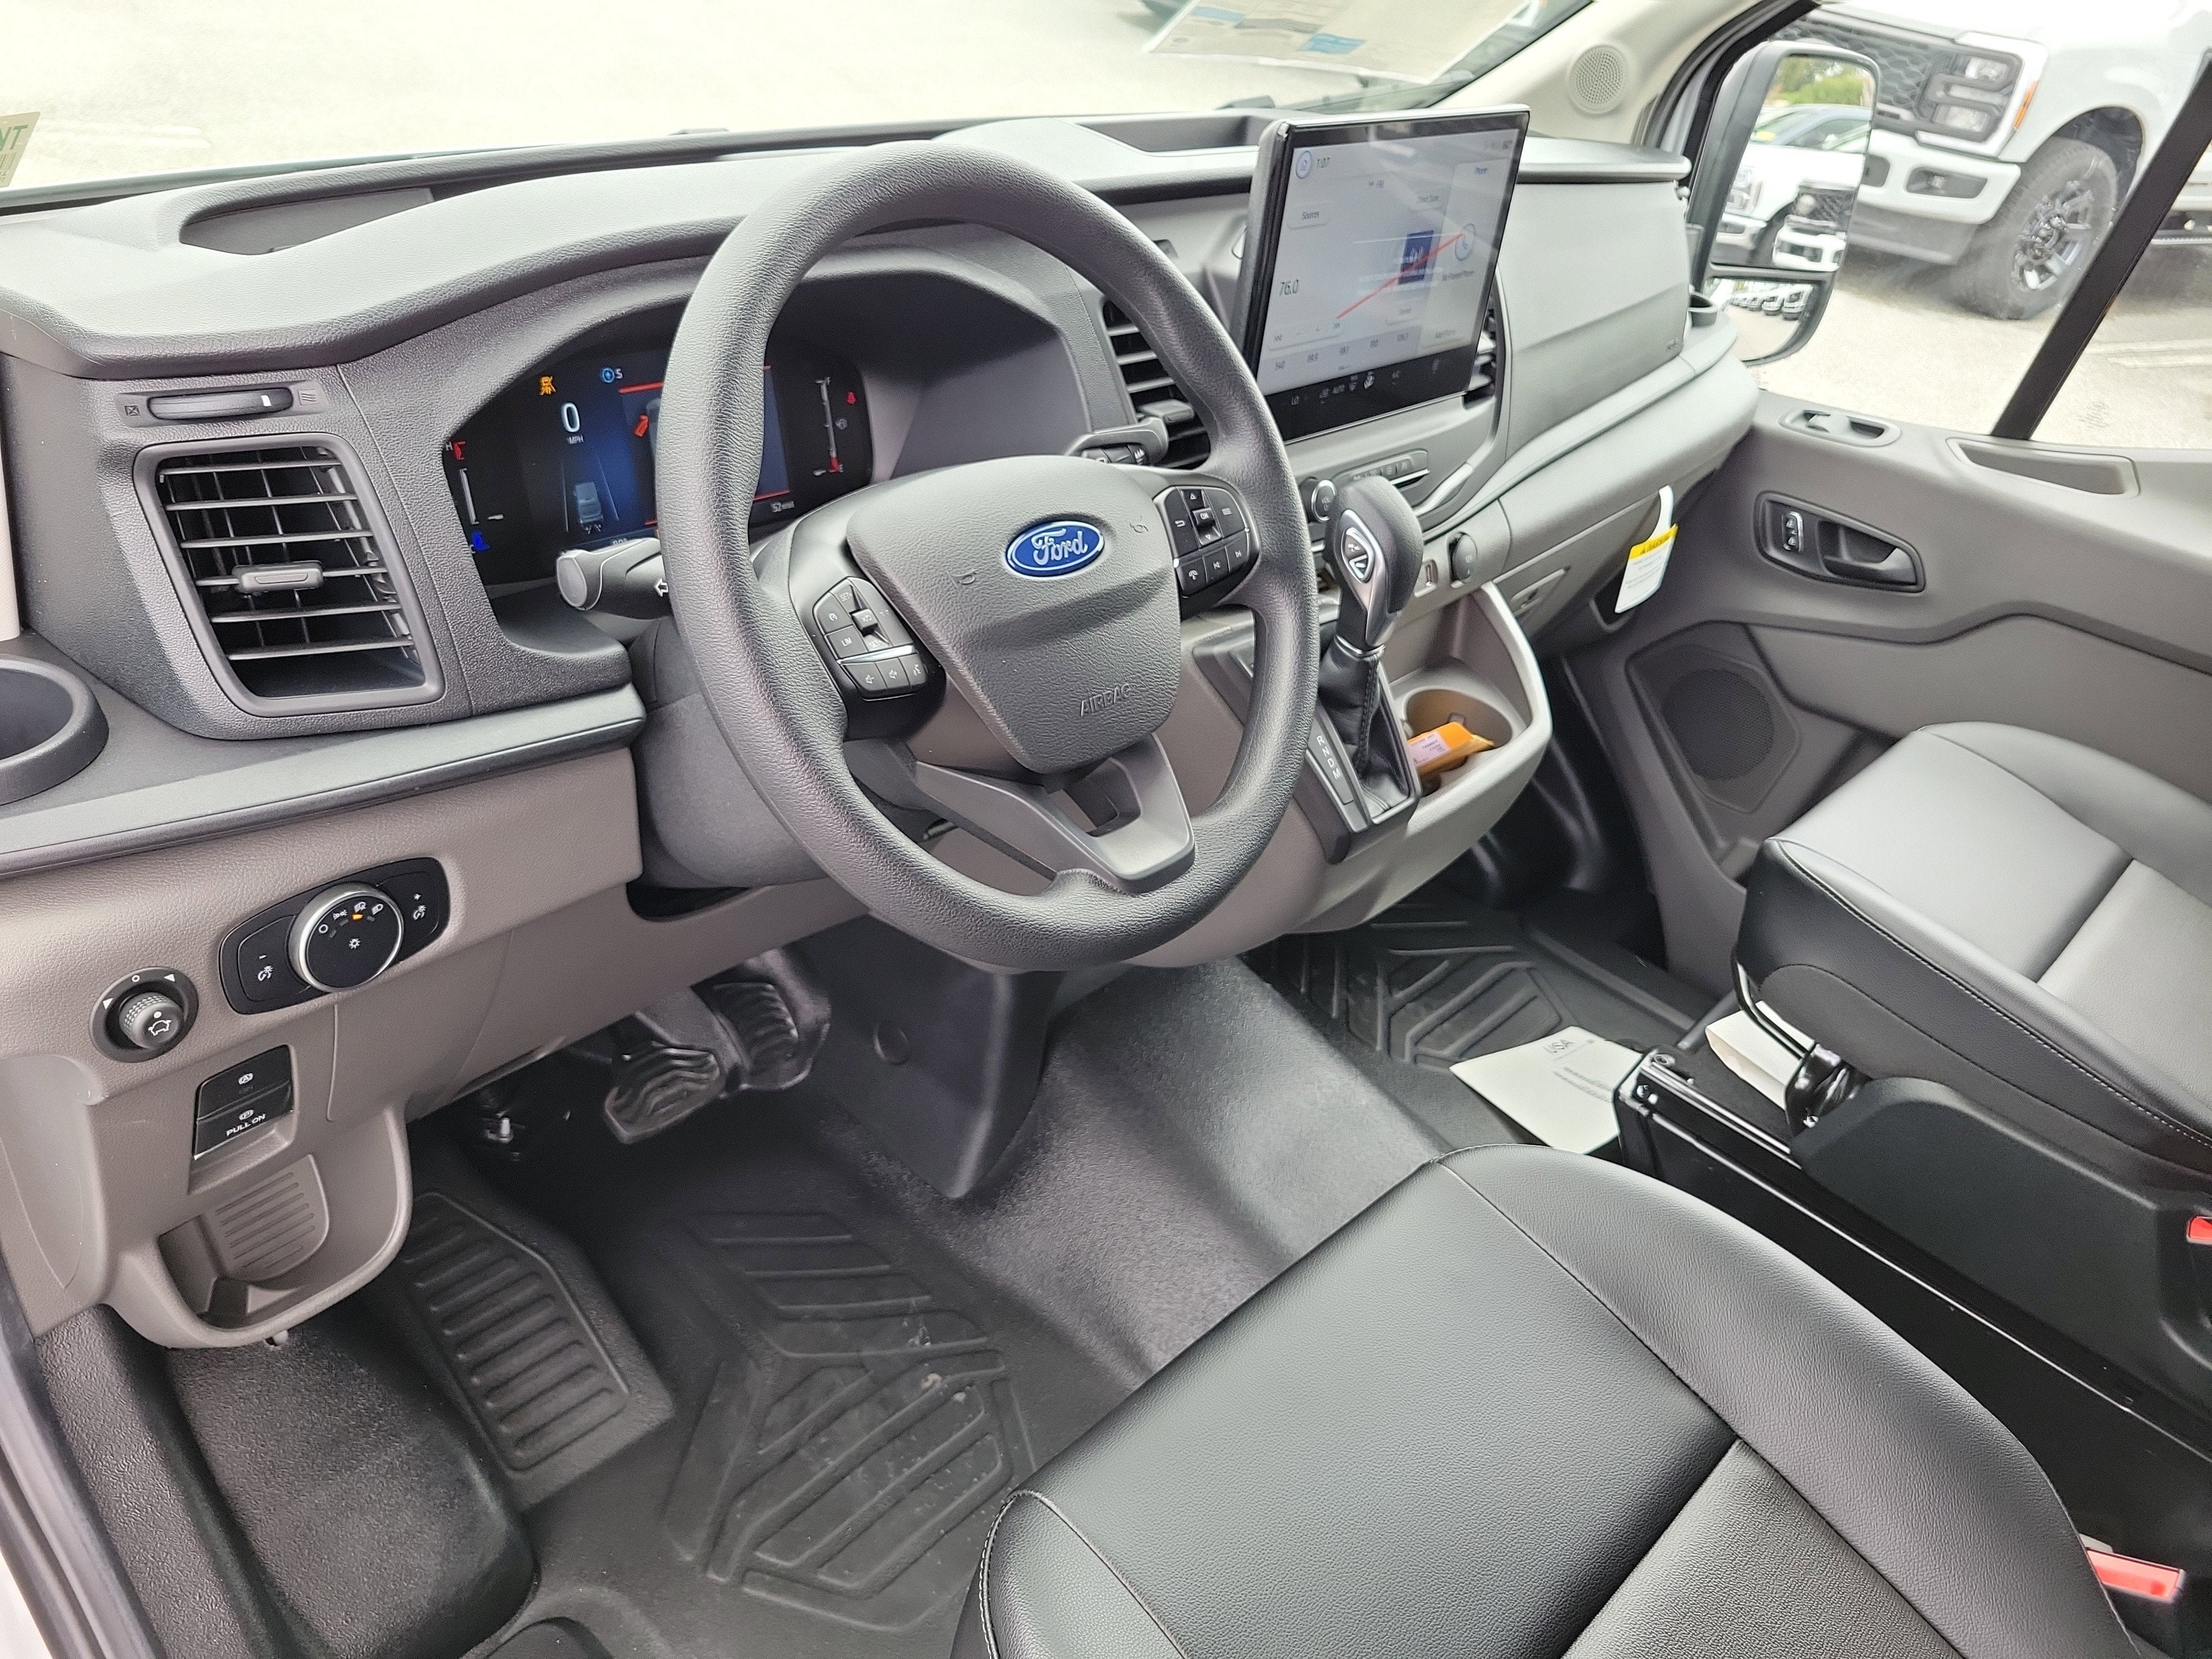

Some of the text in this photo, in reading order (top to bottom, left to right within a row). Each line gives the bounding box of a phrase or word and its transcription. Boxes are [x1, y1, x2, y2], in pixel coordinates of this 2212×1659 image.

[1279, 279, 1299, 296] 76.0
[562, 402, 580, 433] 0
[568, 435, 584, 444] MPH
[445, 441, 453, 451] H
[1031, 528, 1088, 566] Ford
[840, 637, 853, 647] LIM
[1080, 683, 1131, 716] AIRBAG
[1317, 735, 1325, 746] R
[1322, 746, 1330, 757] N
[1327, 758, 1334, 768] D
[1333, 768, 1341, 779] M
[1542, 1039, 1574, 1053] USA
[226, 1114, 266, 1136] PULL ON
